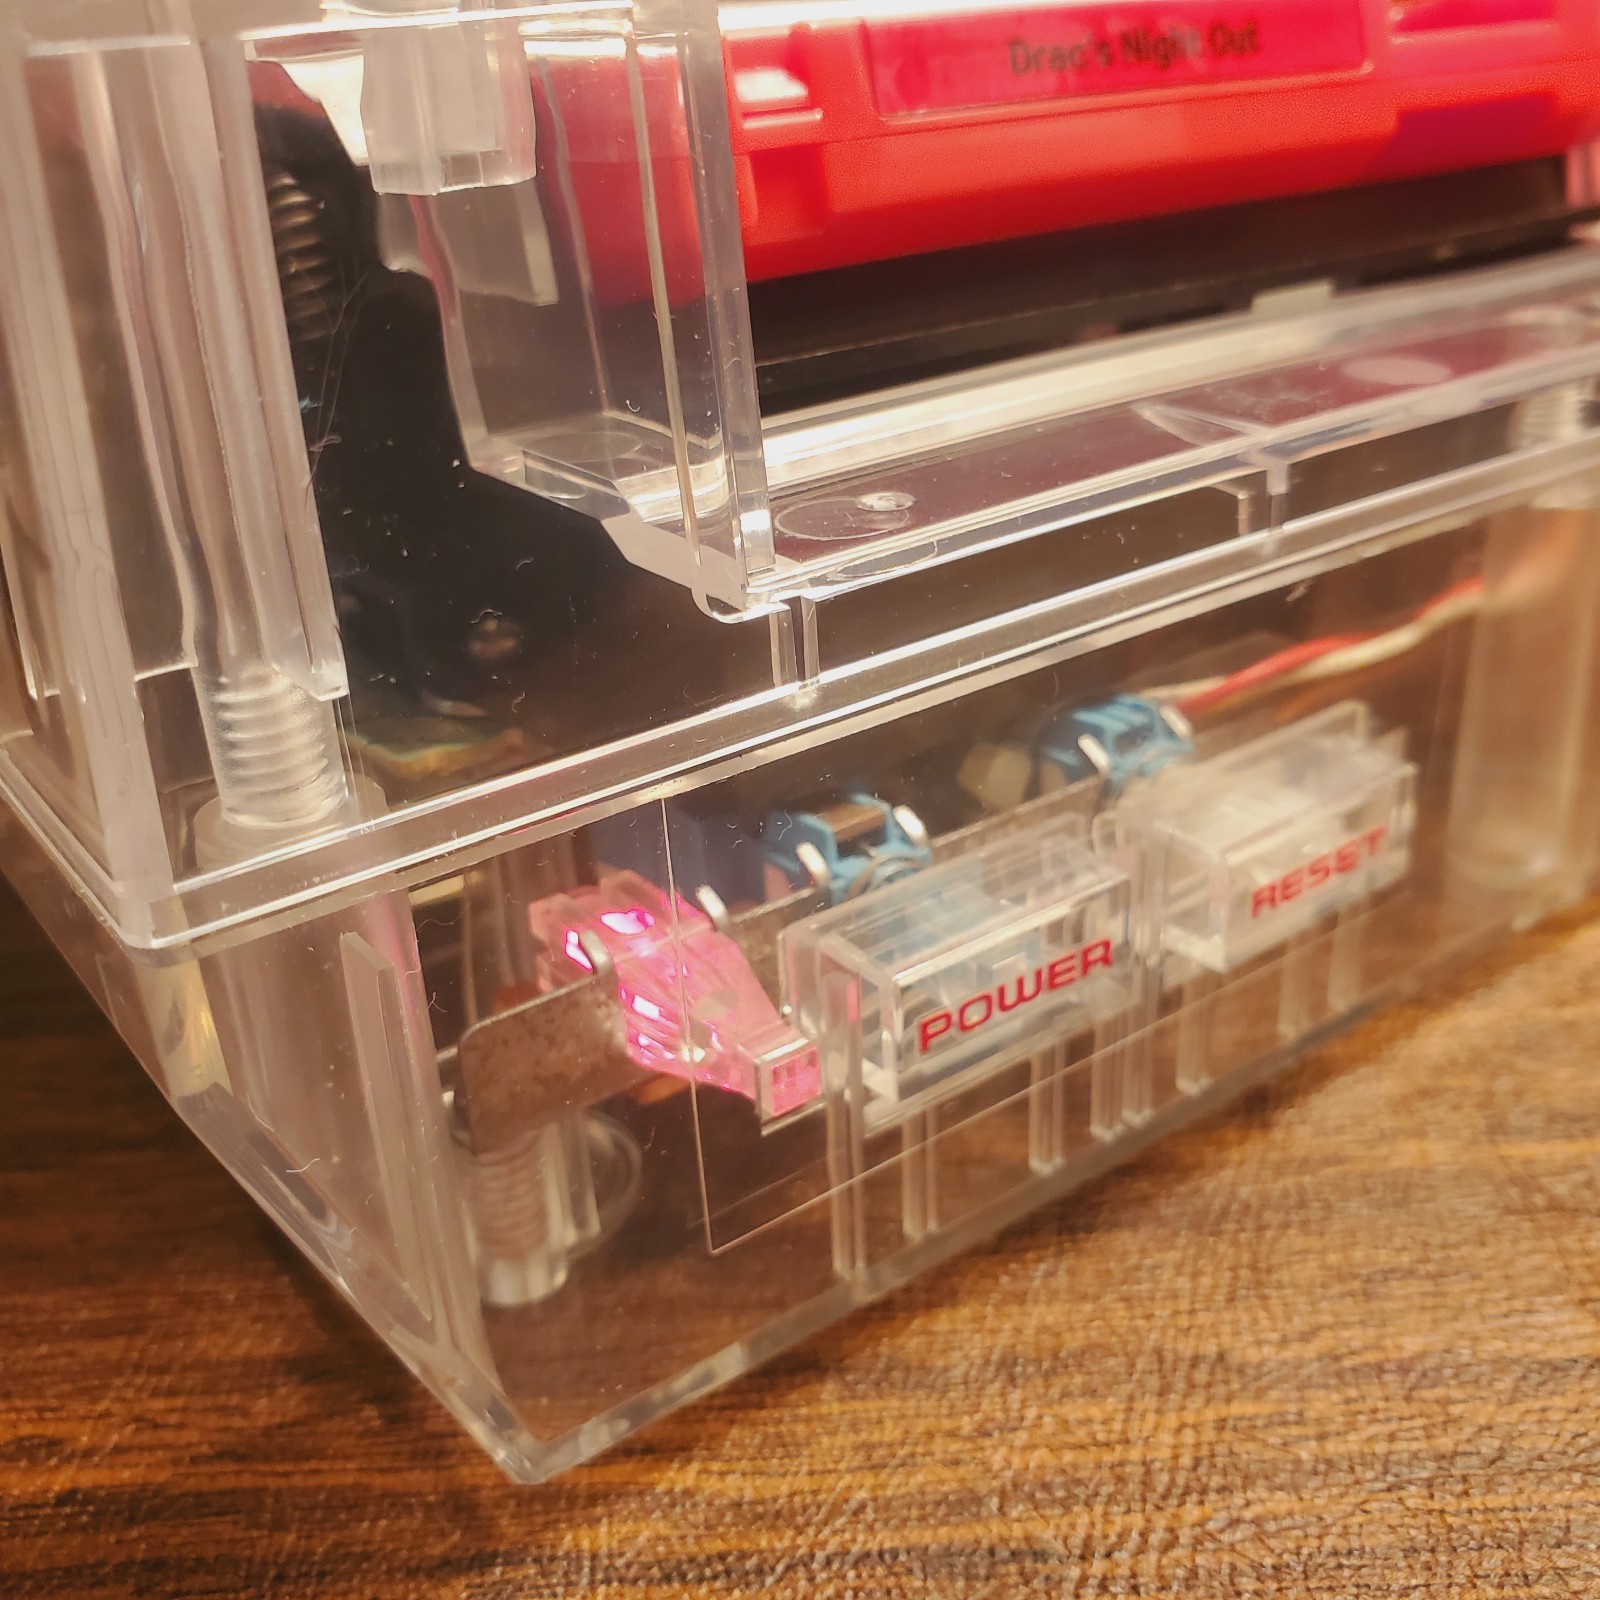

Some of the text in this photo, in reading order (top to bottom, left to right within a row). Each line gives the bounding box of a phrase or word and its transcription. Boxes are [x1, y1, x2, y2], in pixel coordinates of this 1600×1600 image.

[1008, 19, 1257, 75] Drac's Night Out
[1250, 826, 1386, 918] RESET
[918, 938, 1113, 1052] POWER
